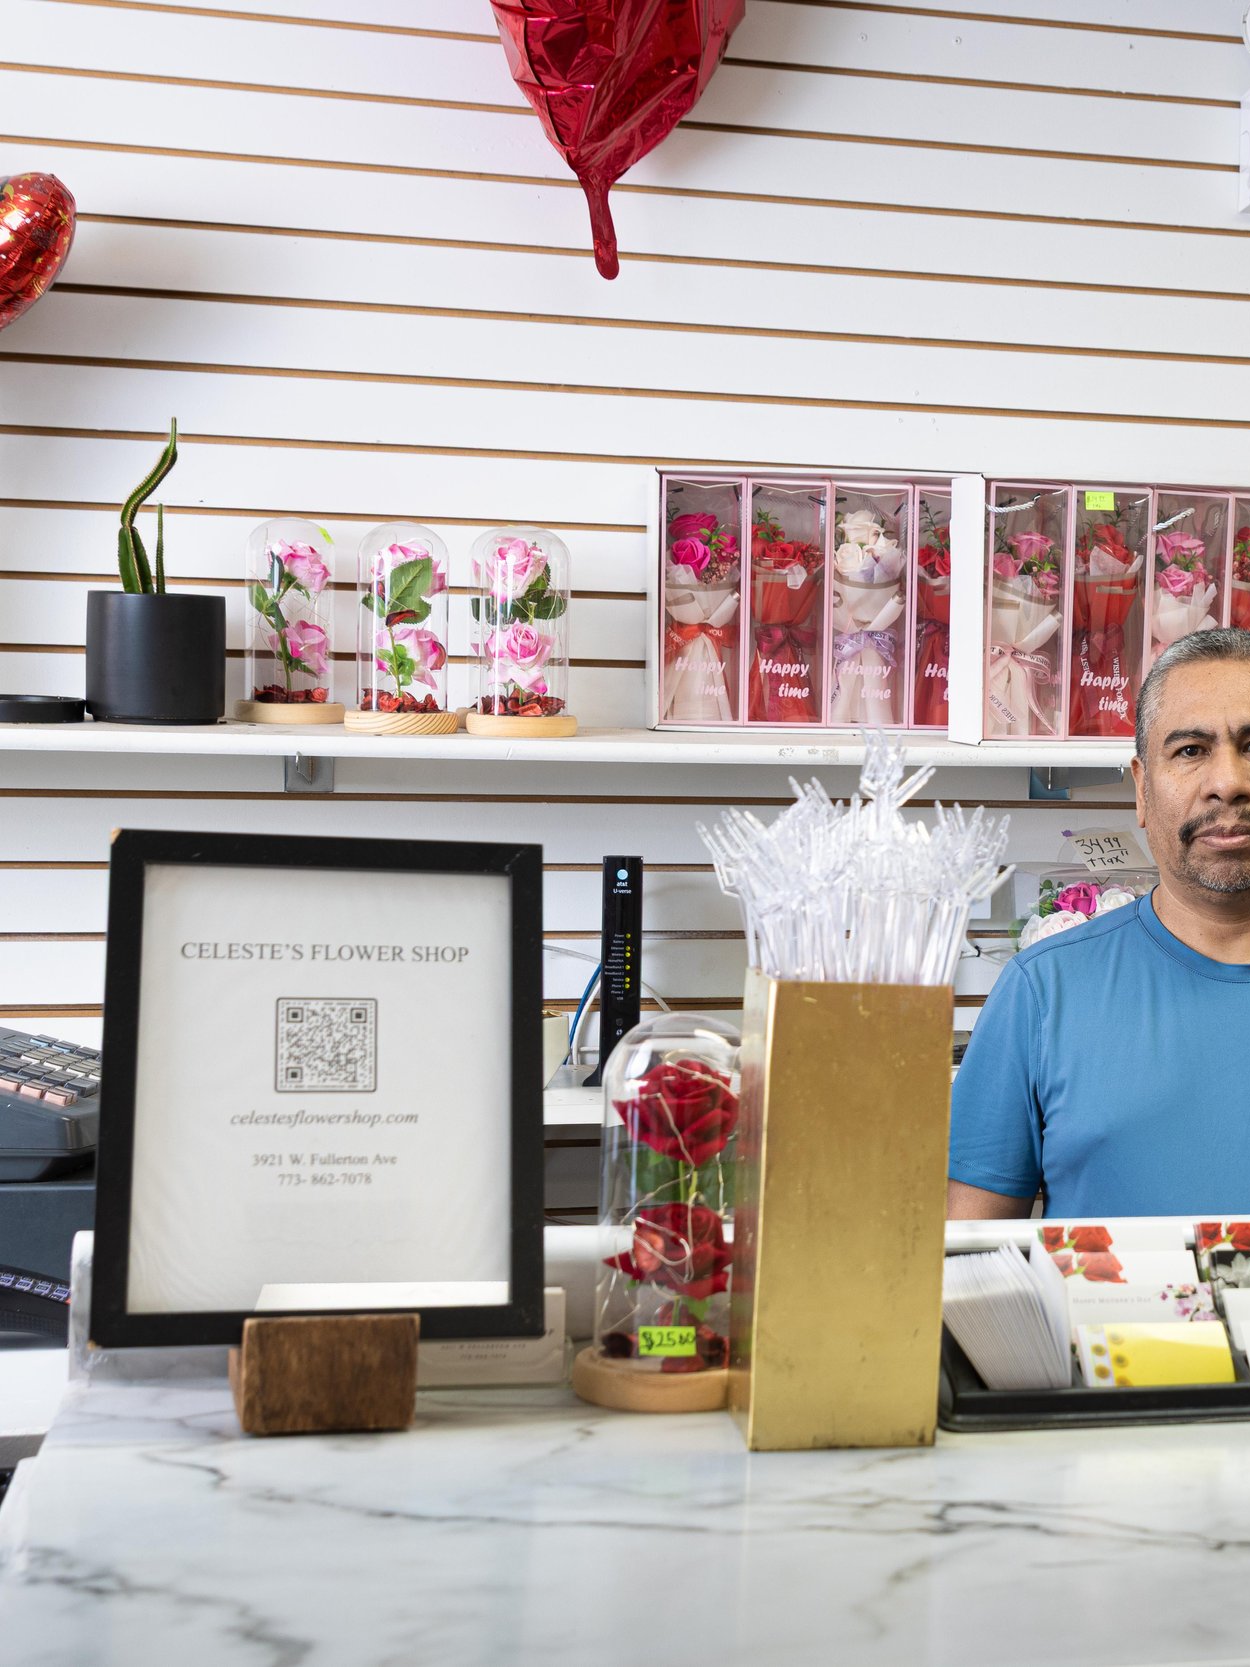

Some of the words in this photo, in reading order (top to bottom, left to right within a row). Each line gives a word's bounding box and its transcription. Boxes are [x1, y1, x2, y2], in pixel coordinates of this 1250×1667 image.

[675, 656, 727, 676] Happy
[759, 658, 810, 678] Happy
[839, 660, 892, 680] Happy
[924, 662, 950, 681] Ha
[1080, 671, 1130, 690] Happy
[778, 683, 810, 699] time
[860, 685, 892, 701] time
[1098, 696, 1129, 713] time
[180, 941, 304, 961] CELESTE'S
[309, 943, 405, 963] FLOWER
[410, 945, 471, 963] SHOP
[230, 1109, 420, 1129] celestesflowershop.com
[252, 1153, 284, 1167] 3921
[288, 1153, 306, 1167] W.
[310, 1152, 369, 1166] Fullerton
[371, 1152, 398, 1166] Ave
[277, 1173, 307, 1187] 773-
[311, 1172, 373, 1186] 862-7078
